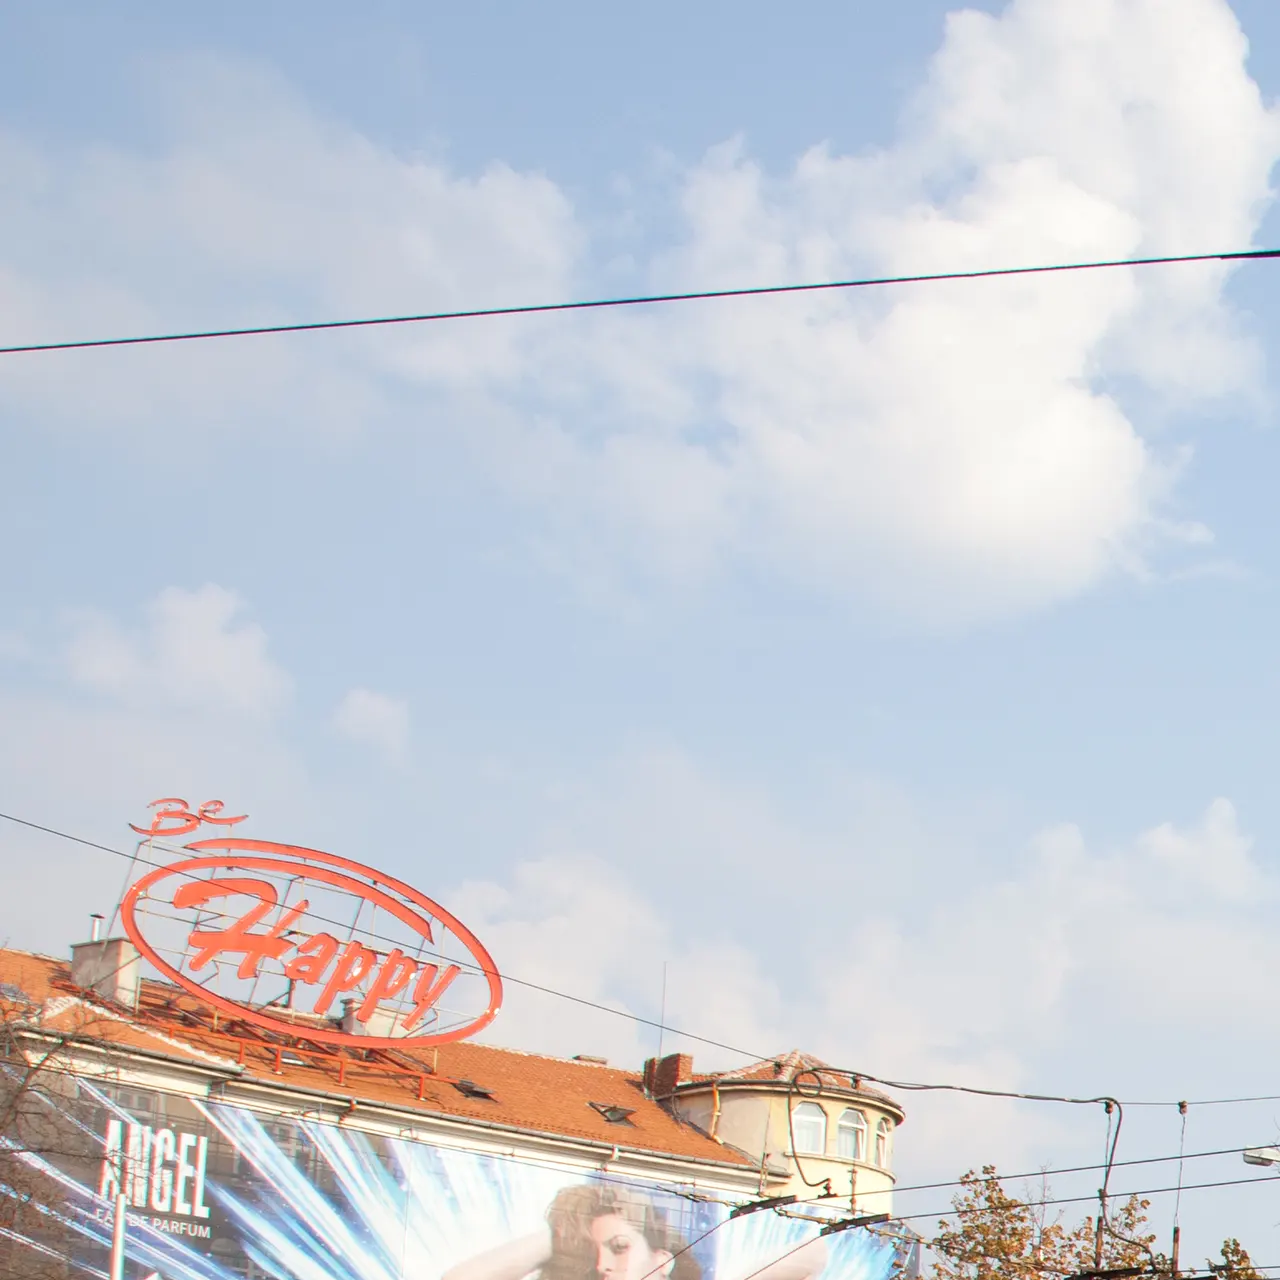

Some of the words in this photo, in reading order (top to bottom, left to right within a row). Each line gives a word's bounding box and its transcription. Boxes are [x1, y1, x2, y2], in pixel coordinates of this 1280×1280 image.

[128, 797, 249, 836] Be
[173, 877, 462, 1031] Happy
[100, 1119, 211, 1219] ANGEL
[153, 1217, 212, 1239] PARFUM
